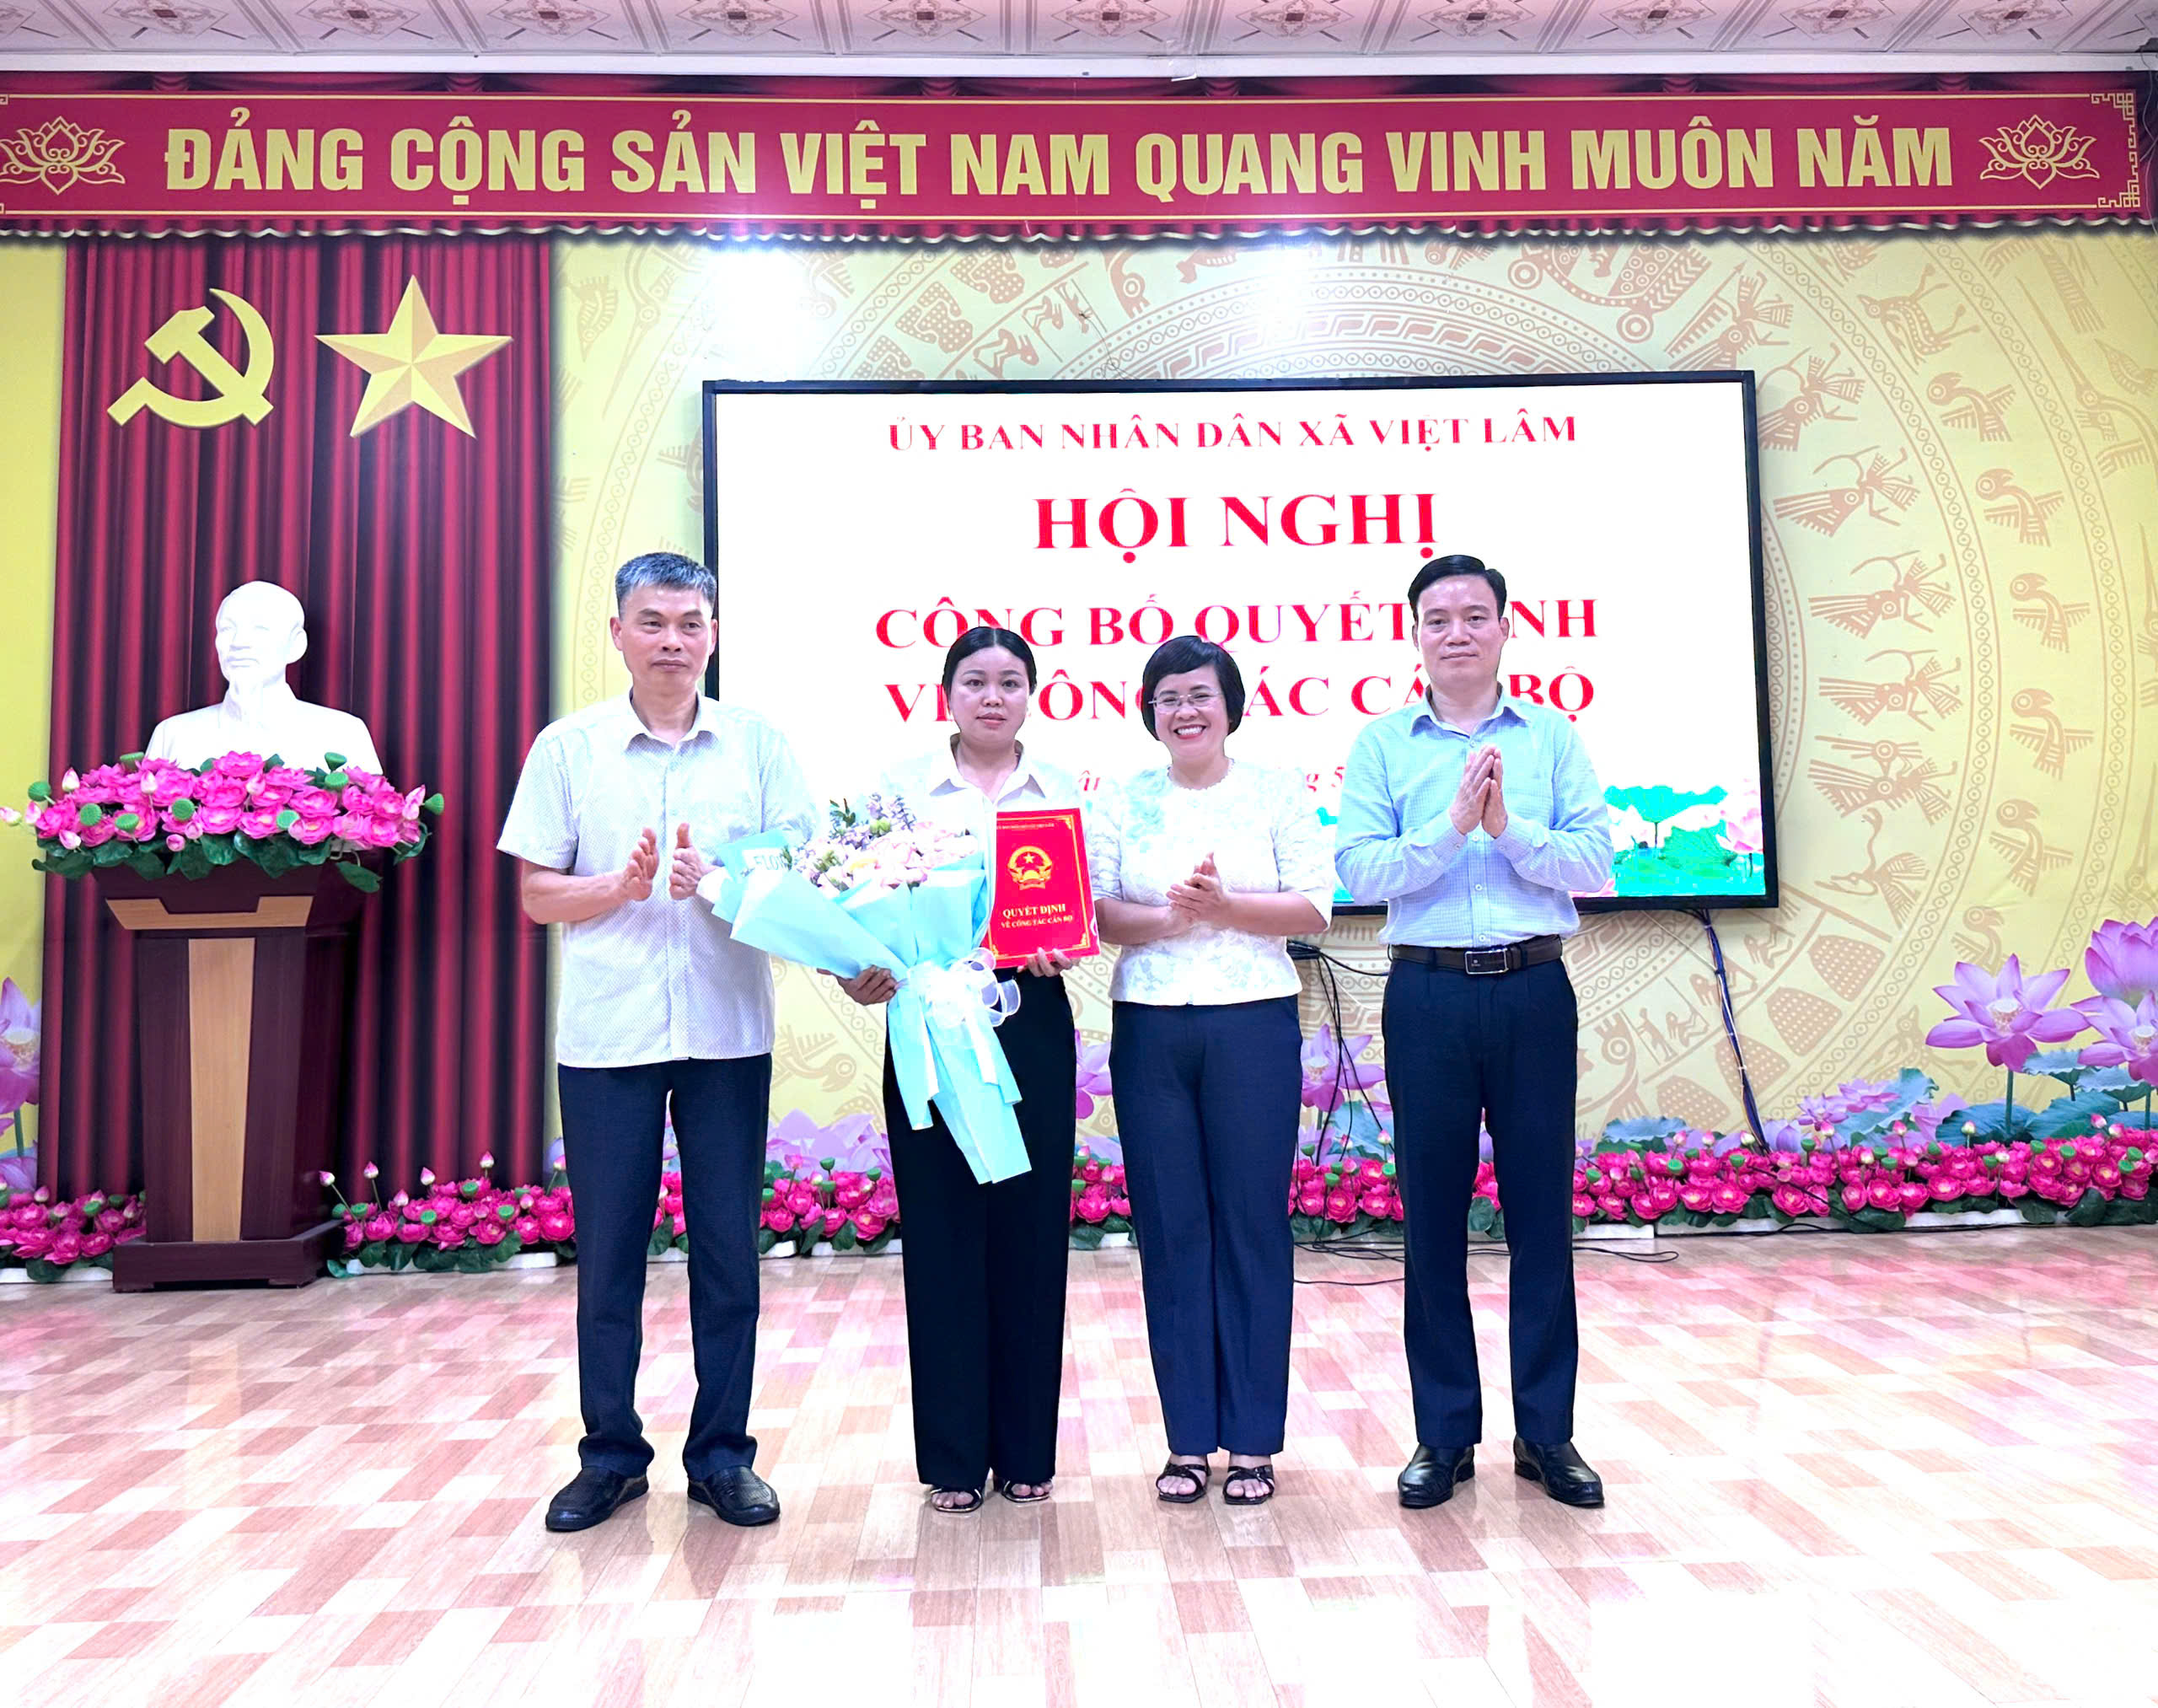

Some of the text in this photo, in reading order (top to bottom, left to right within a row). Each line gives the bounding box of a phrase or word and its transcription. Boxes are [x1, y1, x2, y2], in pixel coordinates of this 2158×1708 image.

[165, 107, 1953, 209] ĐẢNG CỘNG SẢN VIỆT NAM QUANG VINH MUÔN NĂM
[888, 408, 1576, 452] ỦY BAN NHÂN DÂN XÃ VIỆT LÂM
[1034, 487, 1437, 564] HỘI NGHỊ
[1088, 594, 1174, 646] BỐ
[1194, 591, 1406, 653] QUYẾT
[1509, 599, 1598, 638] NH
[1243, 665, 1329, 717] ÁC
[1350, 663, 1425, 716] CÁ
[1003, 905, 1038, 919] QUYẾT
